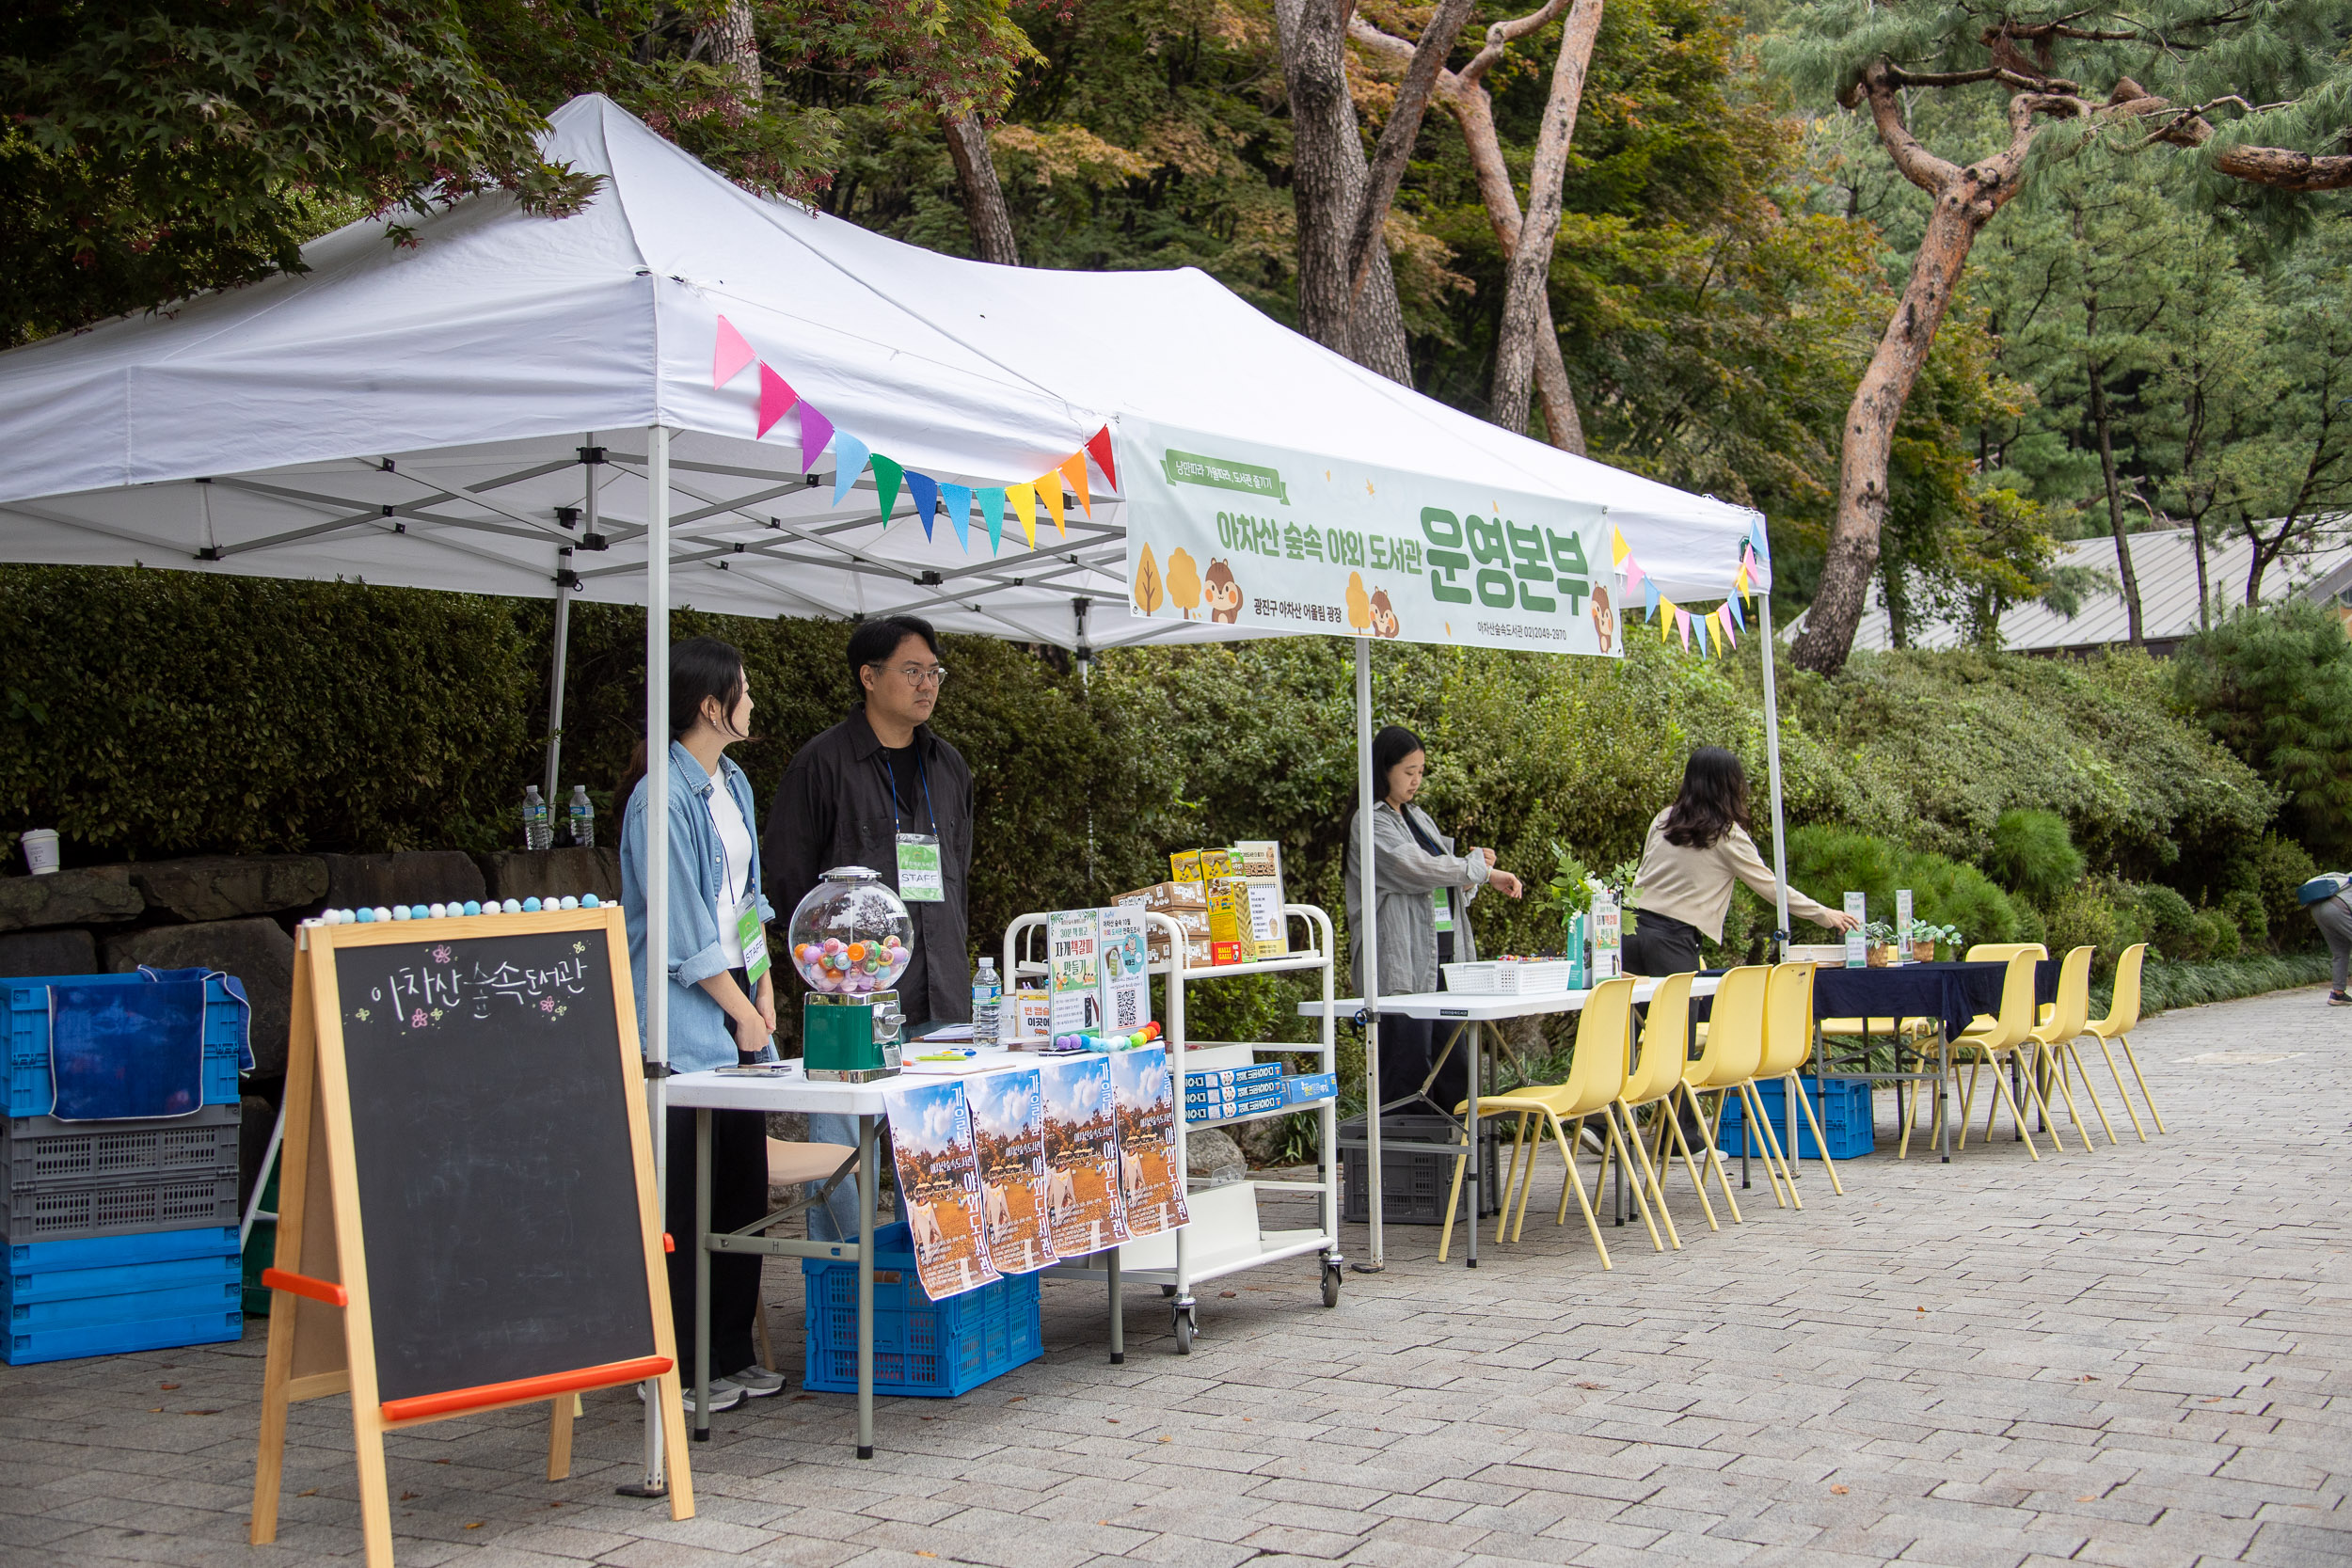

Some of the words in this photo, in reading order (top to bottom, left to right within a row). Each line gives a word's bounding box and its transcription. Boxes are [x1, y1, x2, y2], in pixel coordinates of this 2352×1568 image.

[1175, 460, 1205, 477] 낭만따라
[1232, 471, 1253, 487] 도서관
[1252, 474, 1273, 489] 즐기기
[1216, 511, 1279, 557] 아차산
[1283, 520, 1324, 562] 숲속
[1327, 527, 1365, 568] 야외
[1369, 533, 1422, 575] 도서관
[1420, 506, 1590, 616] 운영본부
[1253, 597, 1278, 617] 광진구
[1279, 601, 1302, 620] 아차산
[1303, 603, 1326, 622] 어울림
[1327, 606, 1342, 623] 광장
[1477, 621, 1523, 638] 아차산숲속도서관
[1523, 627, 1567, 641] 02)2049-2970
[901, 873, 938, 882] STAFF
[745, 939, 764, 963] STAFF
[1063, 959, 1086, 975] 만들기
[371, 966, 462, 1022] 아차산
[1025, 1006, 1032, 1016] 빈
